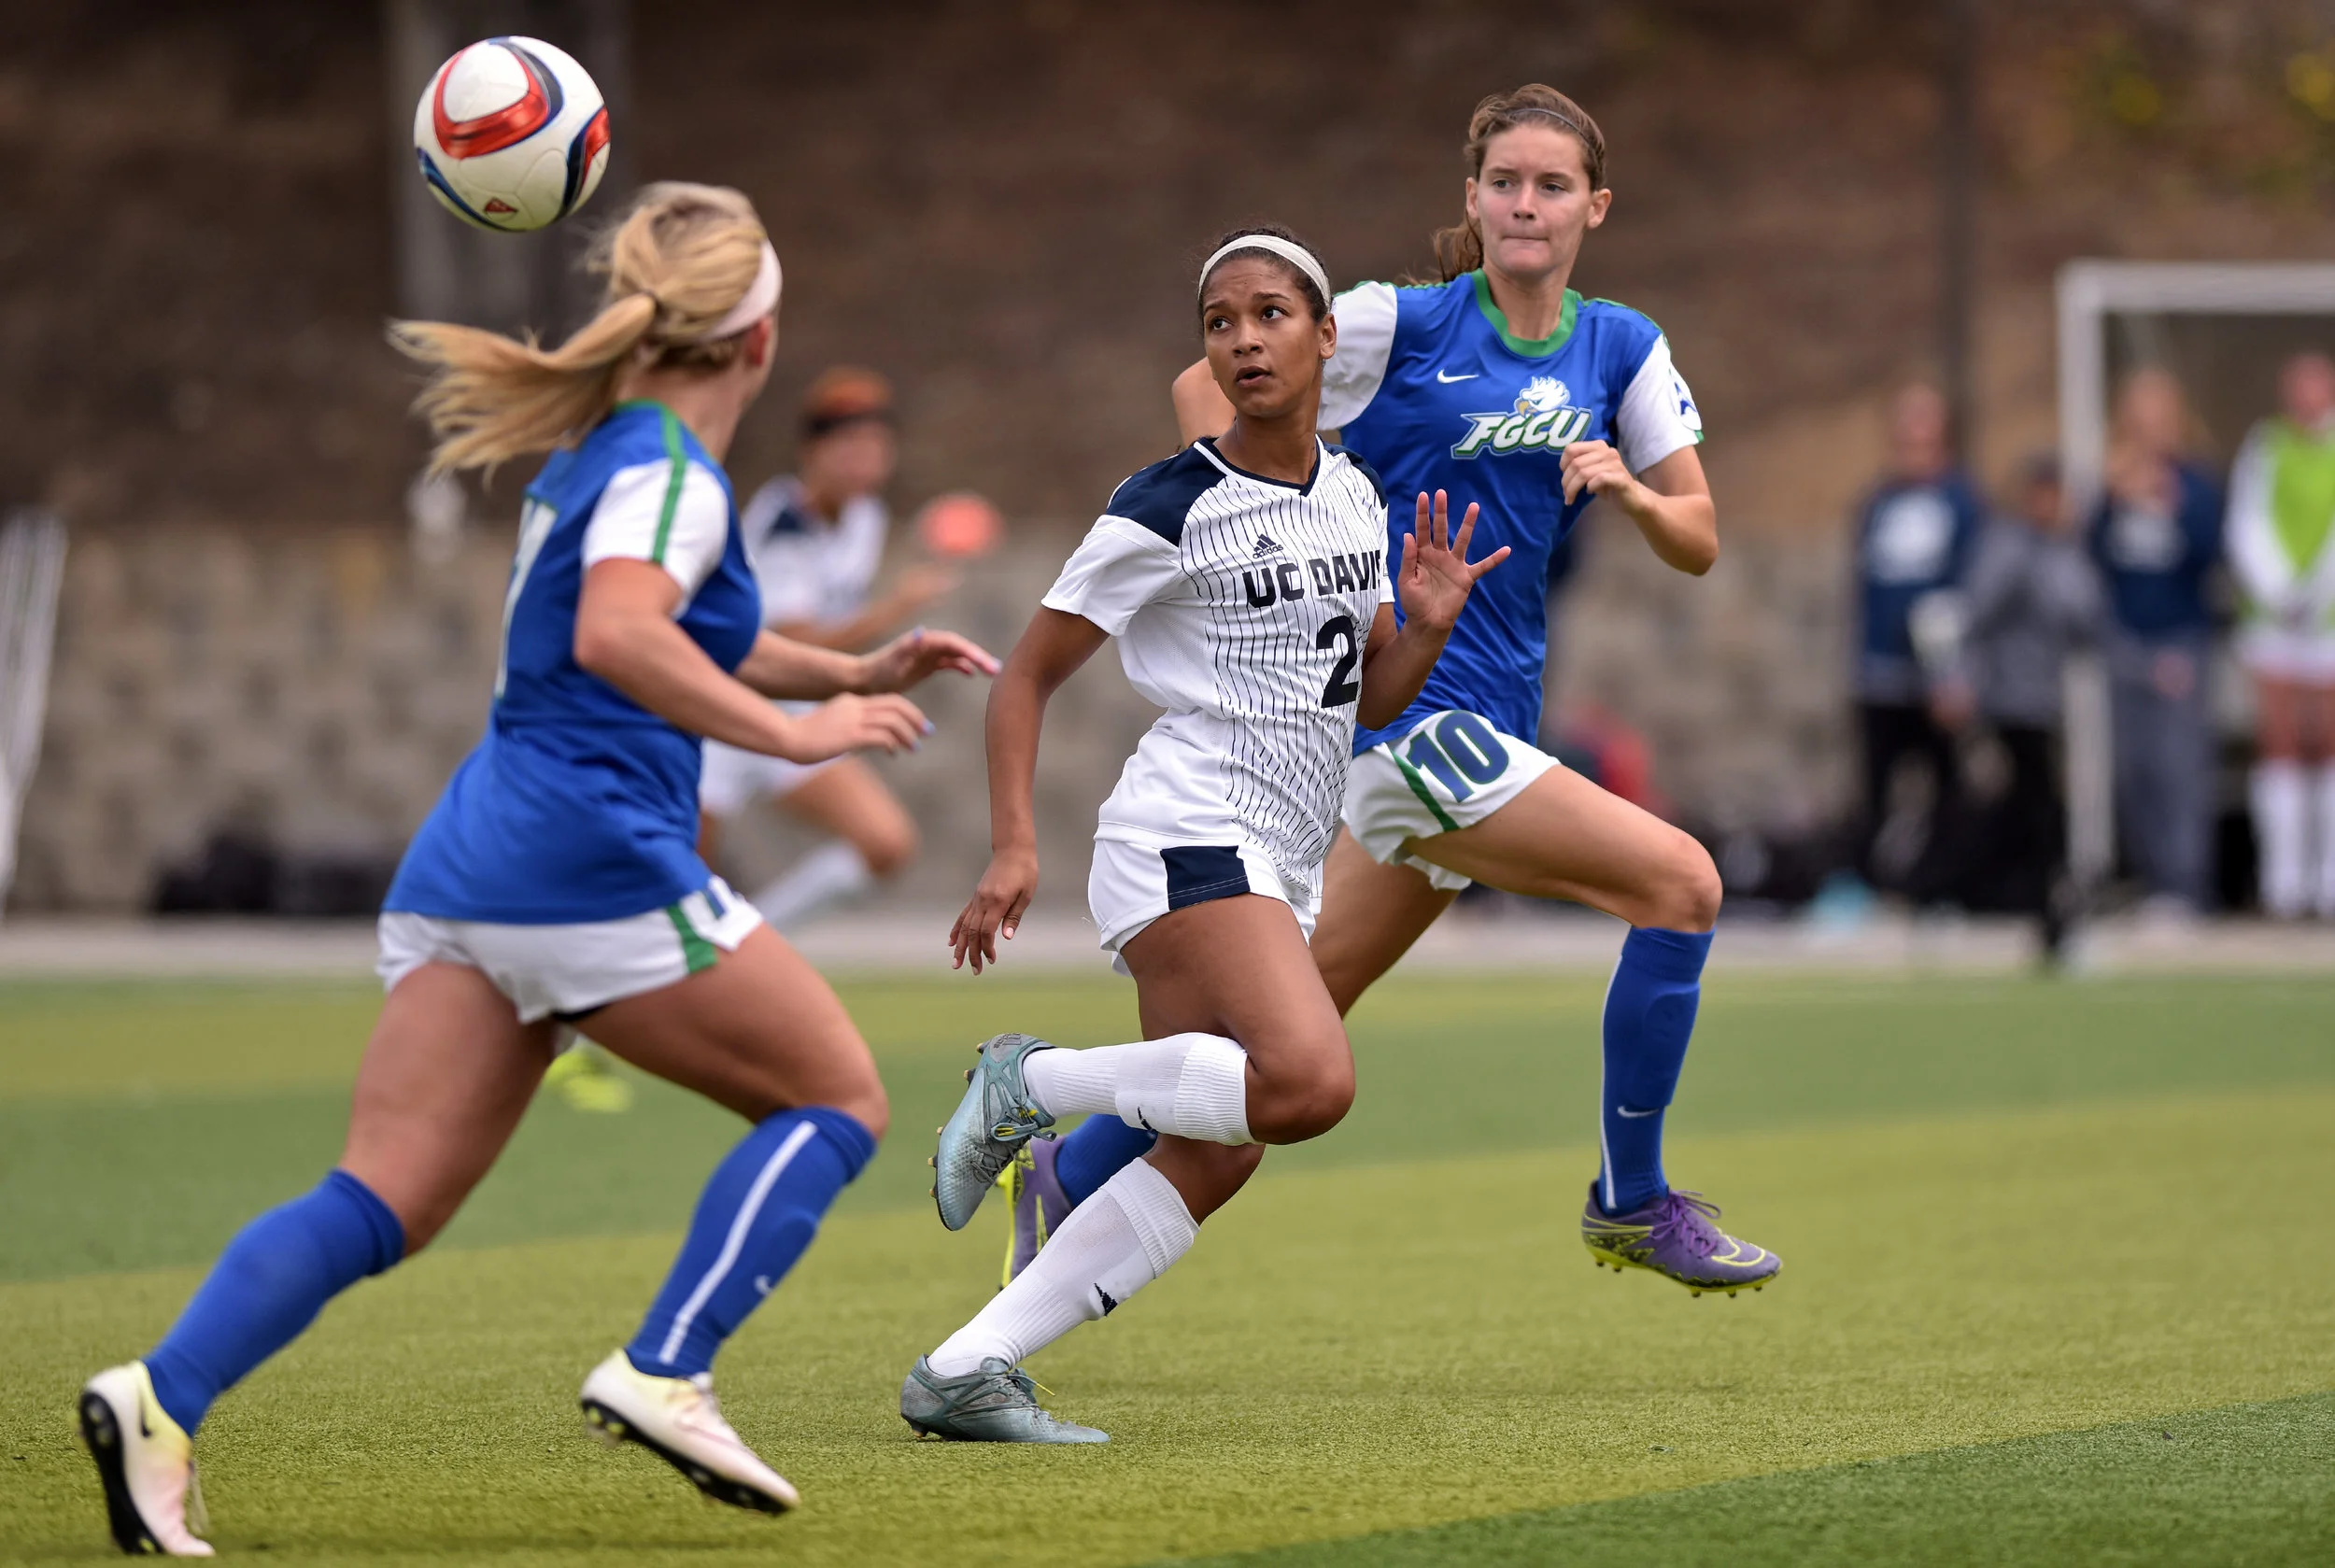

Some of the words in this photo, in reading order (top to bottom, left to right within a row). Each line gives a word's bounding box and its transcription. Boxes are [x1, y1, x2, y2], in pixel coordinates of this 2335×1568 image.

[1451, 406, 1592, 459] FGCU
[1252, 544, 1284, 559] adidas
[1242, 562, 1305, 608] UC
[1316, 615, 1359, 708] 2
[1406, 710, 1509, 803] 10
